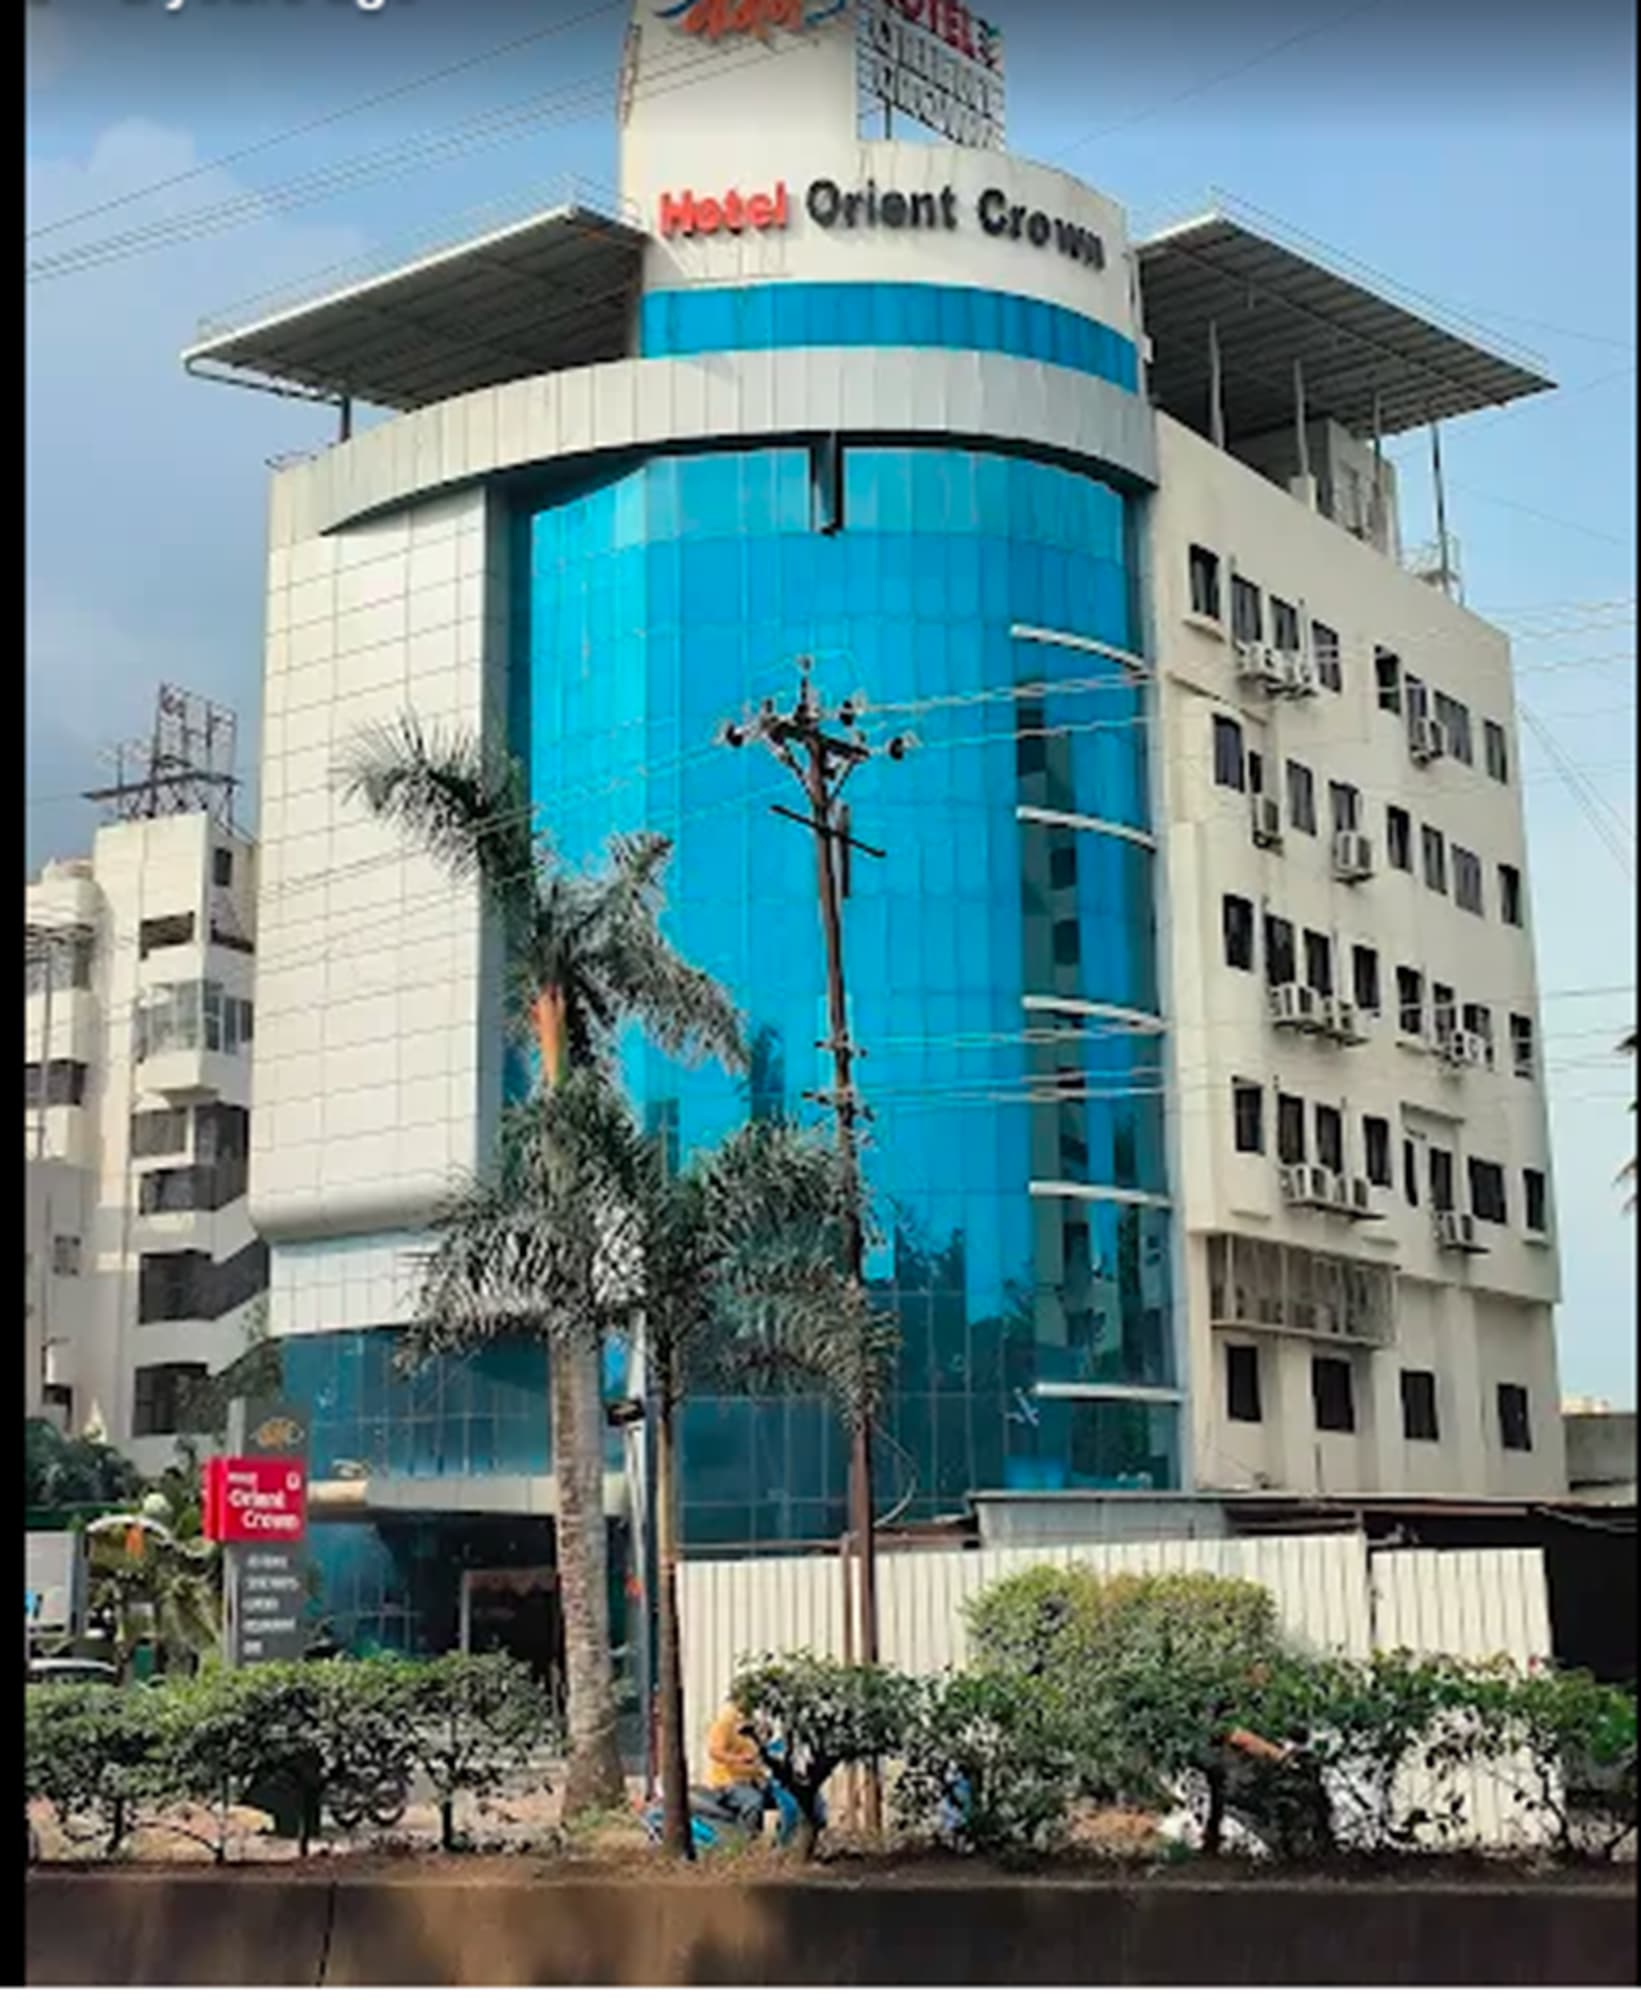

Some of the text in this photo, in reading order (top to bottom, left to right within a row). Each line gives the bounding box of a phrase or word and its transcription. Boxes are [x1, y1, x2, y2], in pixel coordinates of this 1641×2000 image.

[660, 178, 1105, 270] Hotel Orient Crown
[228, 1489, 287, 1509] Orient
[241, 1509, 300, 1530] Crown
